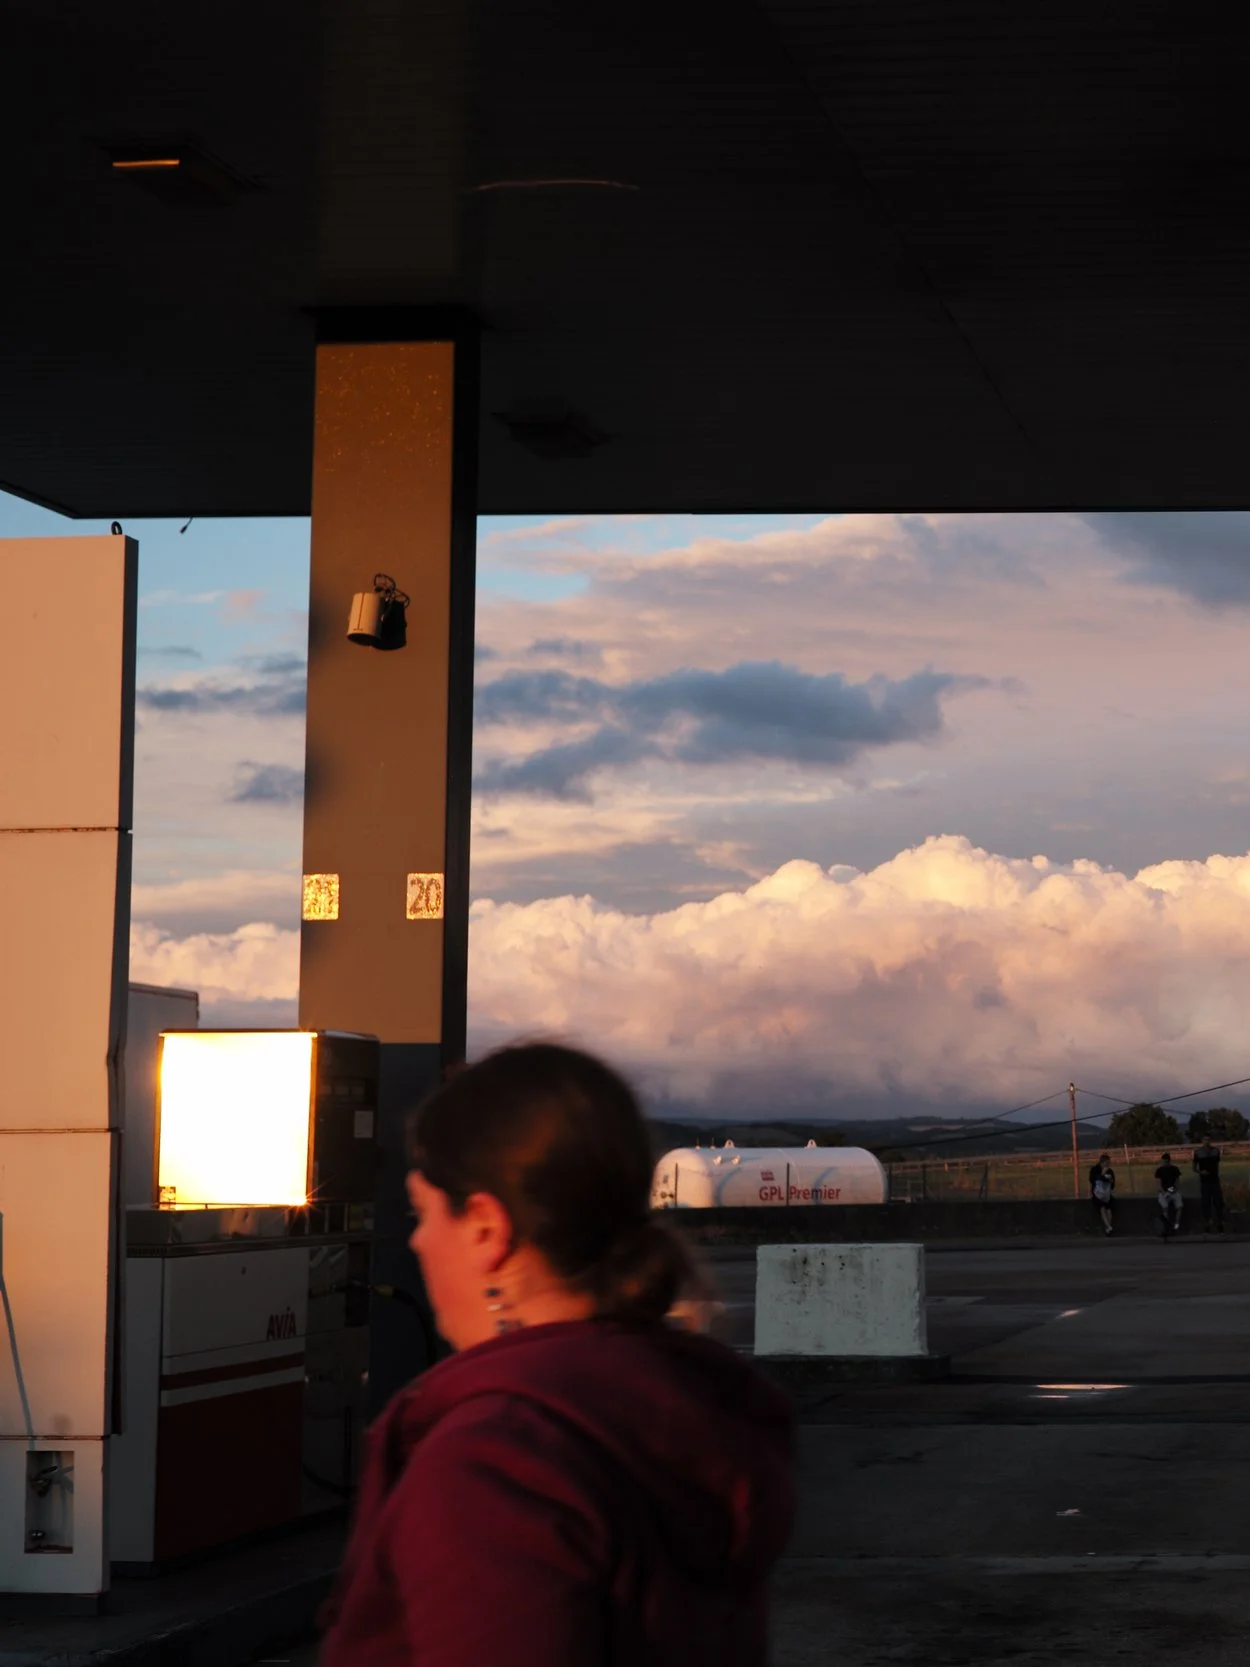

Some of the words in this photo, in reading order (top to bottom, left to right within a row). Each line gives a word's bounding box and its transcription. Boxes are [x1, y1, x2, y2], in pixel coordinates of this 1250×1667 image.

[409, 878, 441, 915] 20
[758, 1186, 785, 1201] GPL
[789, 1184, 841, 1201] Premier
[266, 1306, 297, 1341] AVIA
